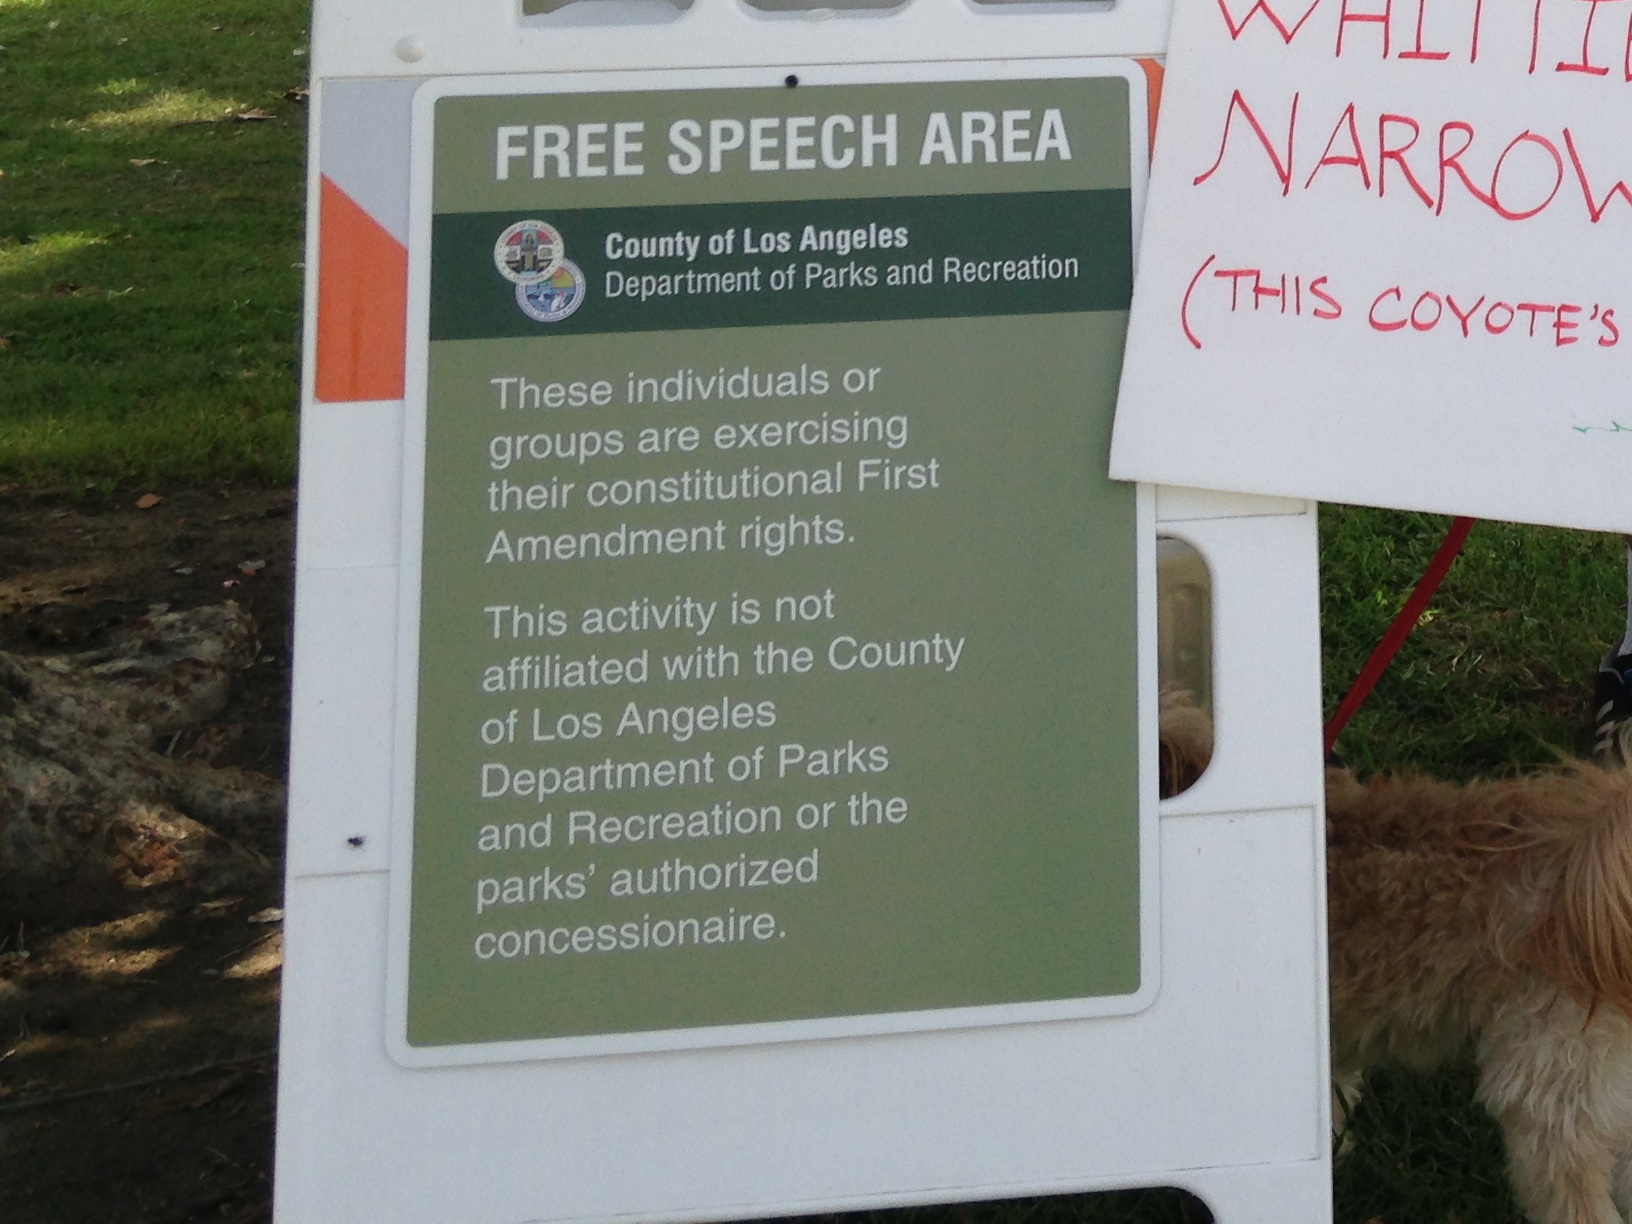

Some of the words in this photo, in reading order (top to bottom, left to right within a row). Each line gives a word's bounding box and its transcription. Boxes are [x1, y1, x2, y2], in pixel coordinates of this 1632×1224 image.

[496, 122, 645, 180] FREE
[668, 113, 898, 175] SPEECH
[919, 108, 1073, 165] AREA
[605, 231, 701, 263] County
[708, 227, 736, 256] of
[743, 224, 794, 255] Los
[799, 222, 909, 258] Angeles
[605, 267, 762, 303] Department
[769, 262, 797, 291] of
[805, 260, 879, 289] Parks
[886, 257, 934, 286] and
[943, 252, 1079, 284] Recreation
[1181, 255, 1343, 349] (THIS
[490, 376, 613, 410] These
[627, 363, 830, 404] individuals
[842, 367, 882, 394] or
[489, 429, 625, 471] groups
[637, 425, 700, 454] are
[713, 410, 909, 450] exercising
[487, 475, 576, 513] their
[586, 460, 843, 507] constitutional
[858, 457, 940, 492] First
[484, 519, 727, 564] Amendment
[740, 513, 855, 557] rights.
[483, 603, 568, 639] This
[581, 595, 718, 637] activity
[731, 591, 761, 625] is
[775, 588, 835, 623] not
[482, 648, 649, 693] affiliated
[662, 644, 739, 681] with
[753, 640, 814, 675] the
[827, 632, 966, 672] County
[481, 708, 519, 745] of
[532, 707, 603, 742] Los
[615, 695, 777, 742] Angeles
[481, 751, 715, 804] Department
[727, 745, 765, 782] of
[778, 739, 889, 779] Parks
[477, 812, 552, 852] and
[568, 800, 782, 846] Recreation
[795, 801, 836, 830] or
[847, 791, 908, 826] the
[610, 847, 819, 897] authorized
[474, 907, 786, 960] concessionaire.
